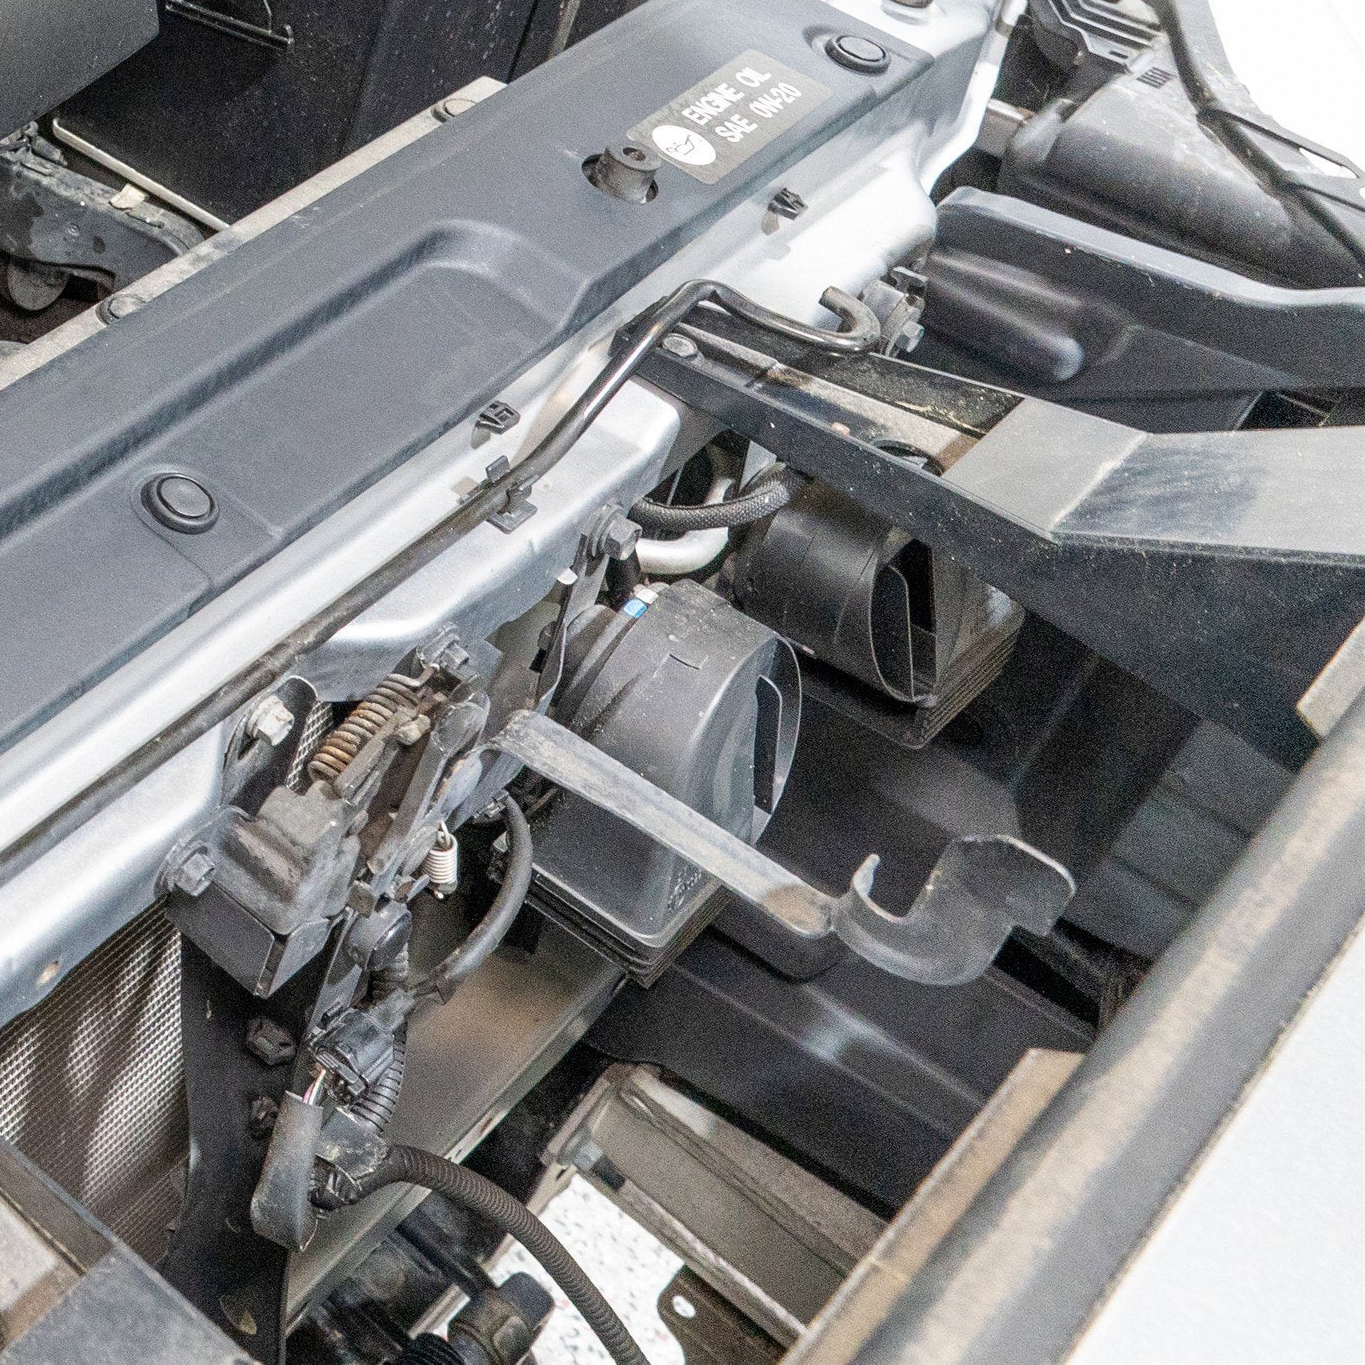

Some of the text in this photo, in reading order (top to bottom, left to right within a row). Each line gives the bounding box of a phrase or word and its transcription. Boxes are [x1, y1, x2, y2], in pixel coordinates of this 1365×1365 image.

[681, 66, 772, 126] ENGINE OIL
[715, 82, 802, 143] SAE 0W-20
